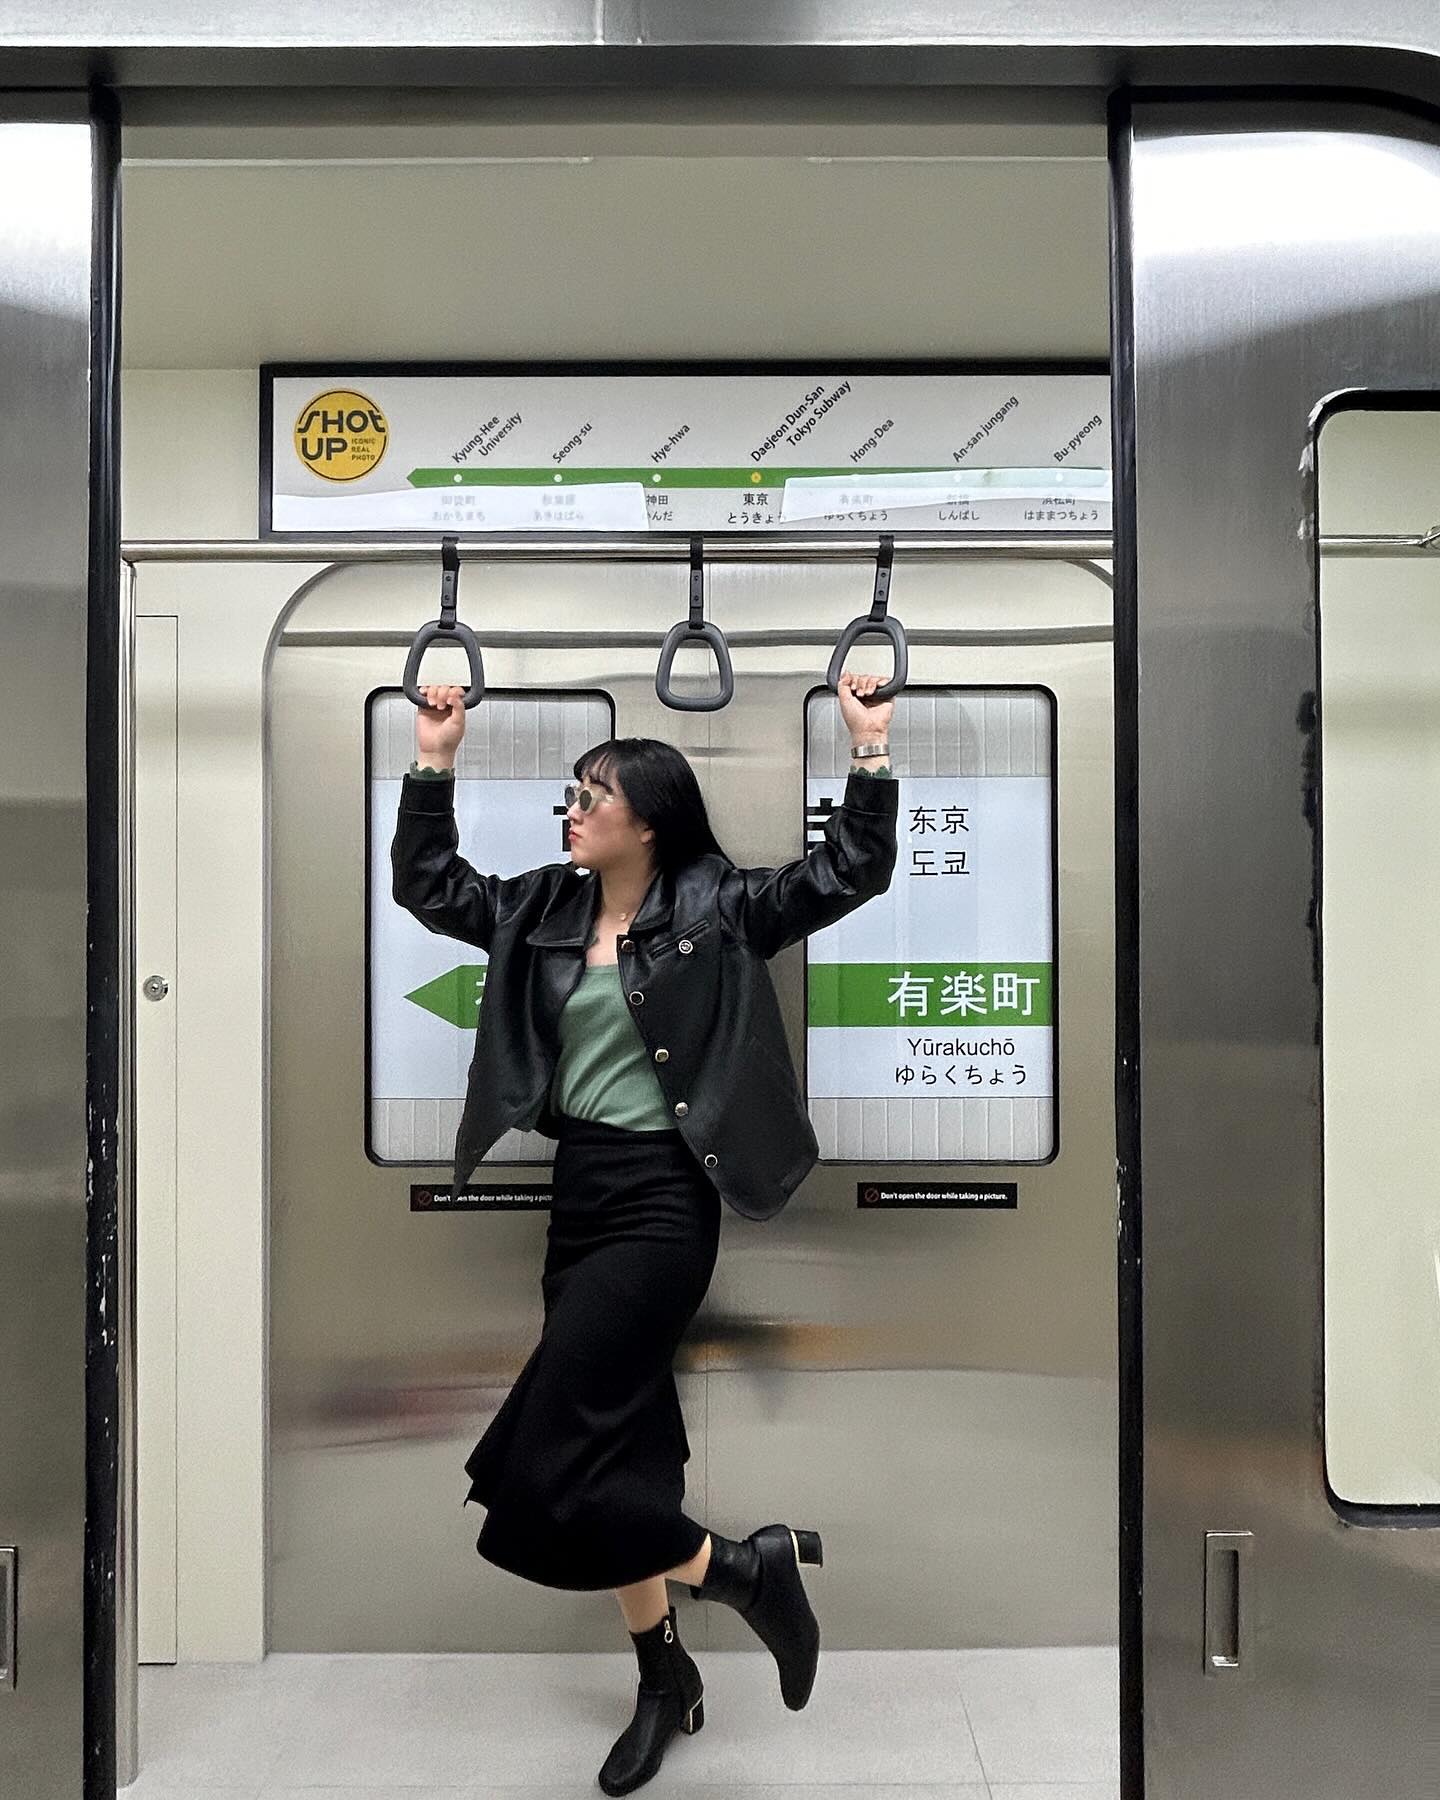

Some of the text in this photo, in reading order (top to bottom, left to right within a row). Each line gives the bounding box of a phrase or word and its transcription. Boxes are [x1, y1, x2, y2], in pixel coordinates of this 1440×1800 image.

[750, 385, 825, 462] Daejeon Dun-San
[786, 380, 852, 448] Tokyo Subway
[952, 395, 1019, 463] An-san jungang
[302, 437, 348, 460] UP
[452, 416, 500, 464] Kyung-Hee
[478, 412, 523, 457] University
[552, 422, 593, 464] Seong-su
[651, 423, 691, 464] Hye-hwa
[850, 418, 894, 463] Hong-Dea
[1053, 414, 1103, 463] Bu-pyeong
[743, 493, 769, 506] 東京
[939, 510, 981, 521] しんばし
[1024, 510, 1099, 521] はままつちょう
[908, 805, 970, 834] 东京
[909, 850, 970, 876] 도쿄
[887, 971, 1041, 1017] 有楽町
[907, 1038, 1015, 1056] Yūrakuchō
[895, 1064, 1027, 1085] ゆらくちょう
[433, 1194, 451, 1202] Don't
[468, 1194, 479, 1202] the
[480, 1194, 495, 1202] door
[496, 1194, 513, 1202] while
[514, 1194, 534, 1204] taking
[880, 1192, 898, 1200] Don't
[898, 1193, 914, 1202] open
[914, 1192, 926, 1200] the
[926, 1192, 941, 1200] door
[941, 1192, 958, 1200] while
[958, 1192, 979, 1202] taking
[984, 1192, 1008, 1202] picture.
